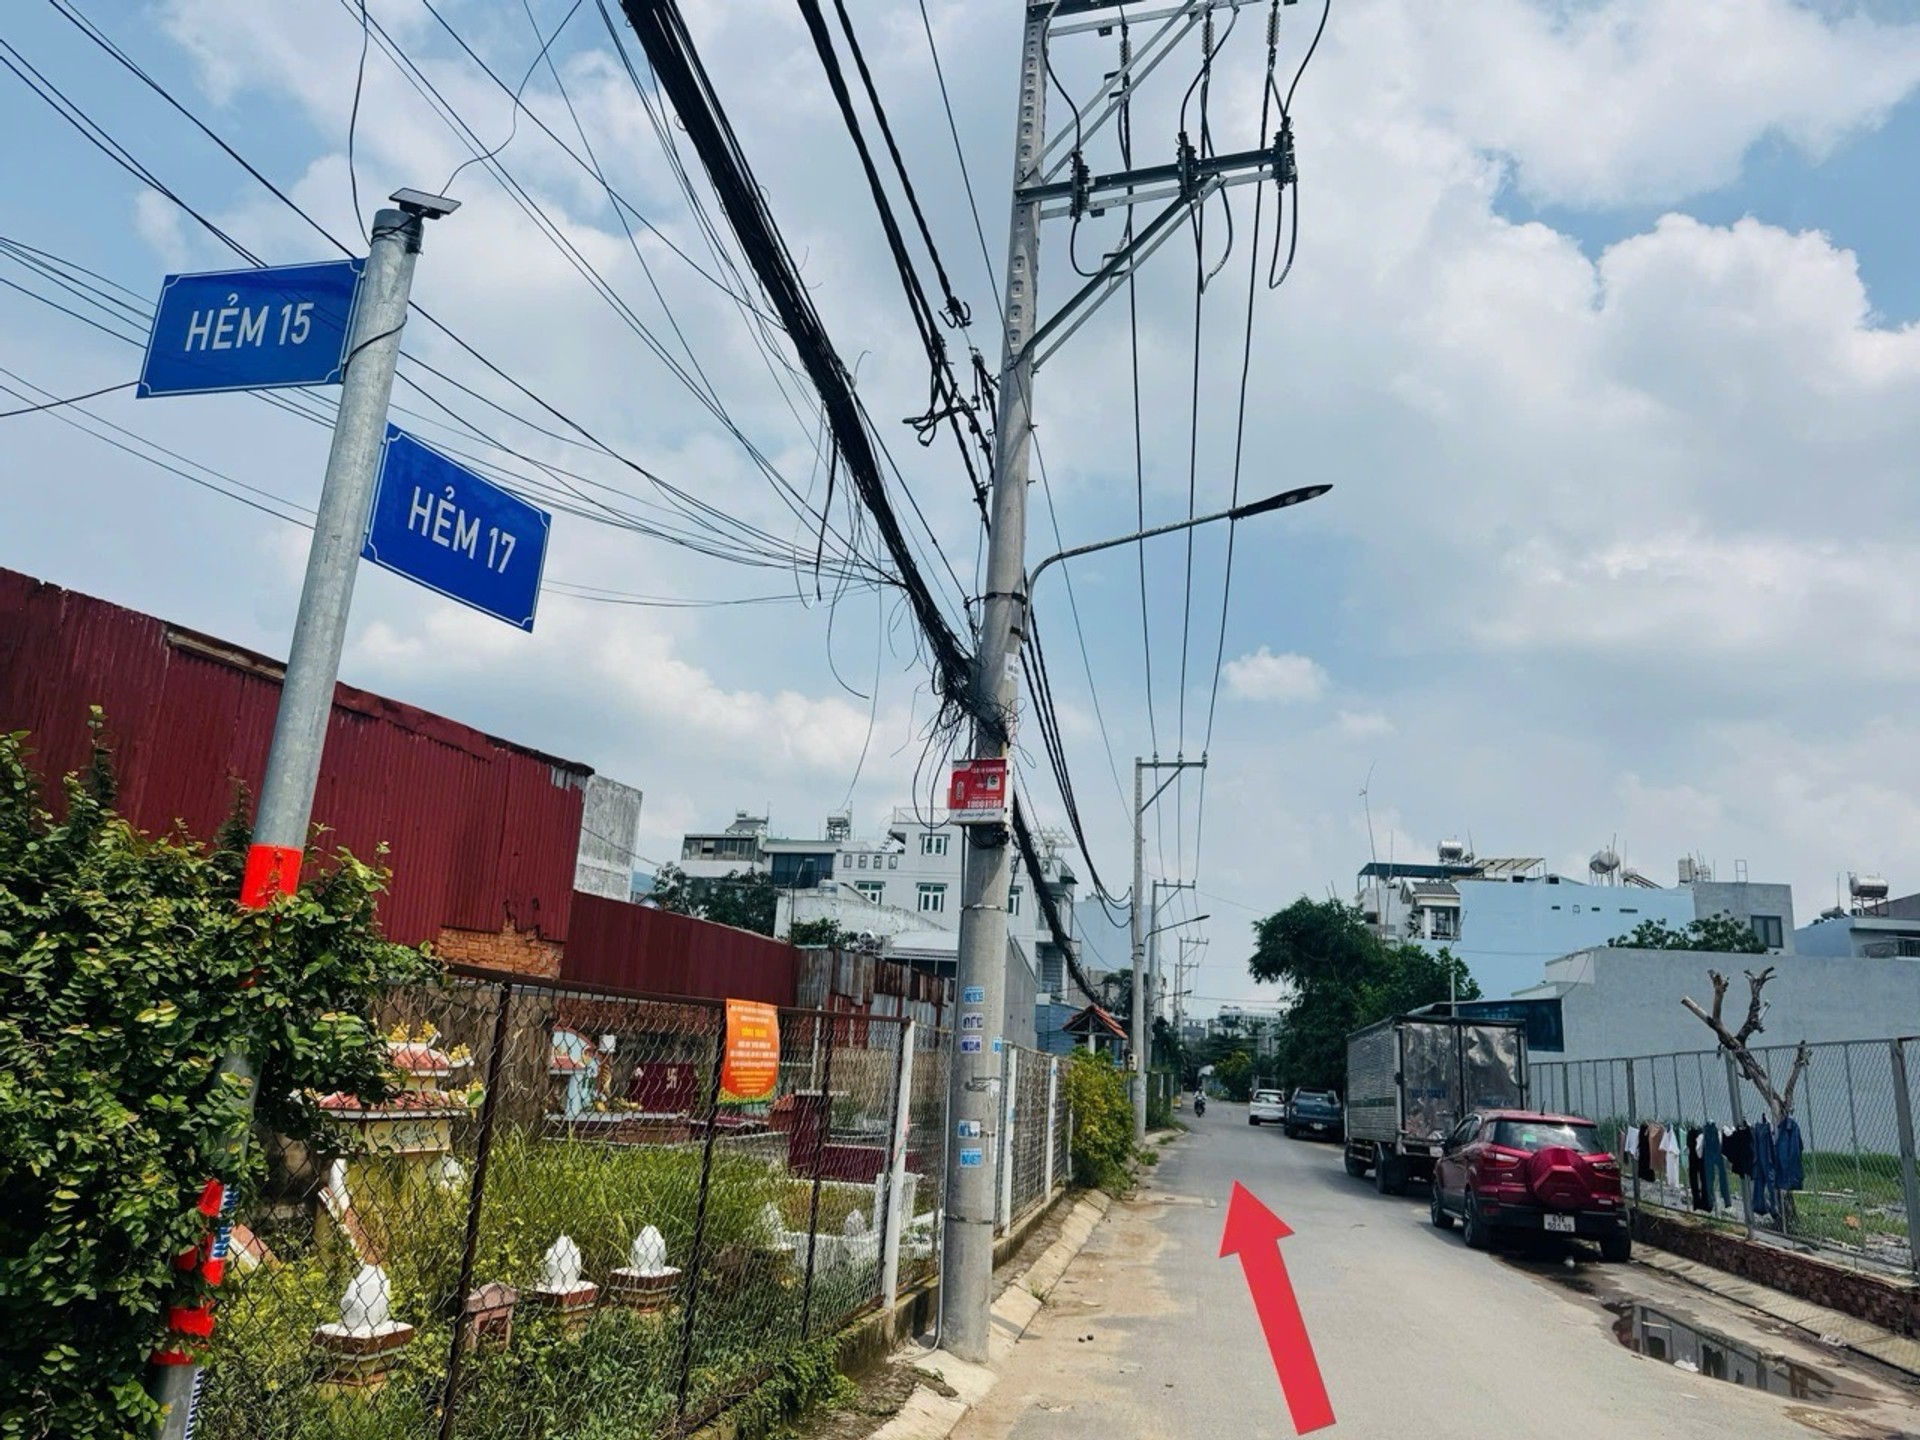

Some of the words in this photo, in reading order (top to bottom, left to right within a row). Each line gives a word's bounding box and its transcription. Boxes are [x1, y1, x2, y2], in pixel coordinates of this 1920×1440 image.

[185, 293, 269, 352] HẺM
[279, 303, 315, 346] 15
[408, 486, 481, 559] HẺM
[488, 527, 516, 574] 17
